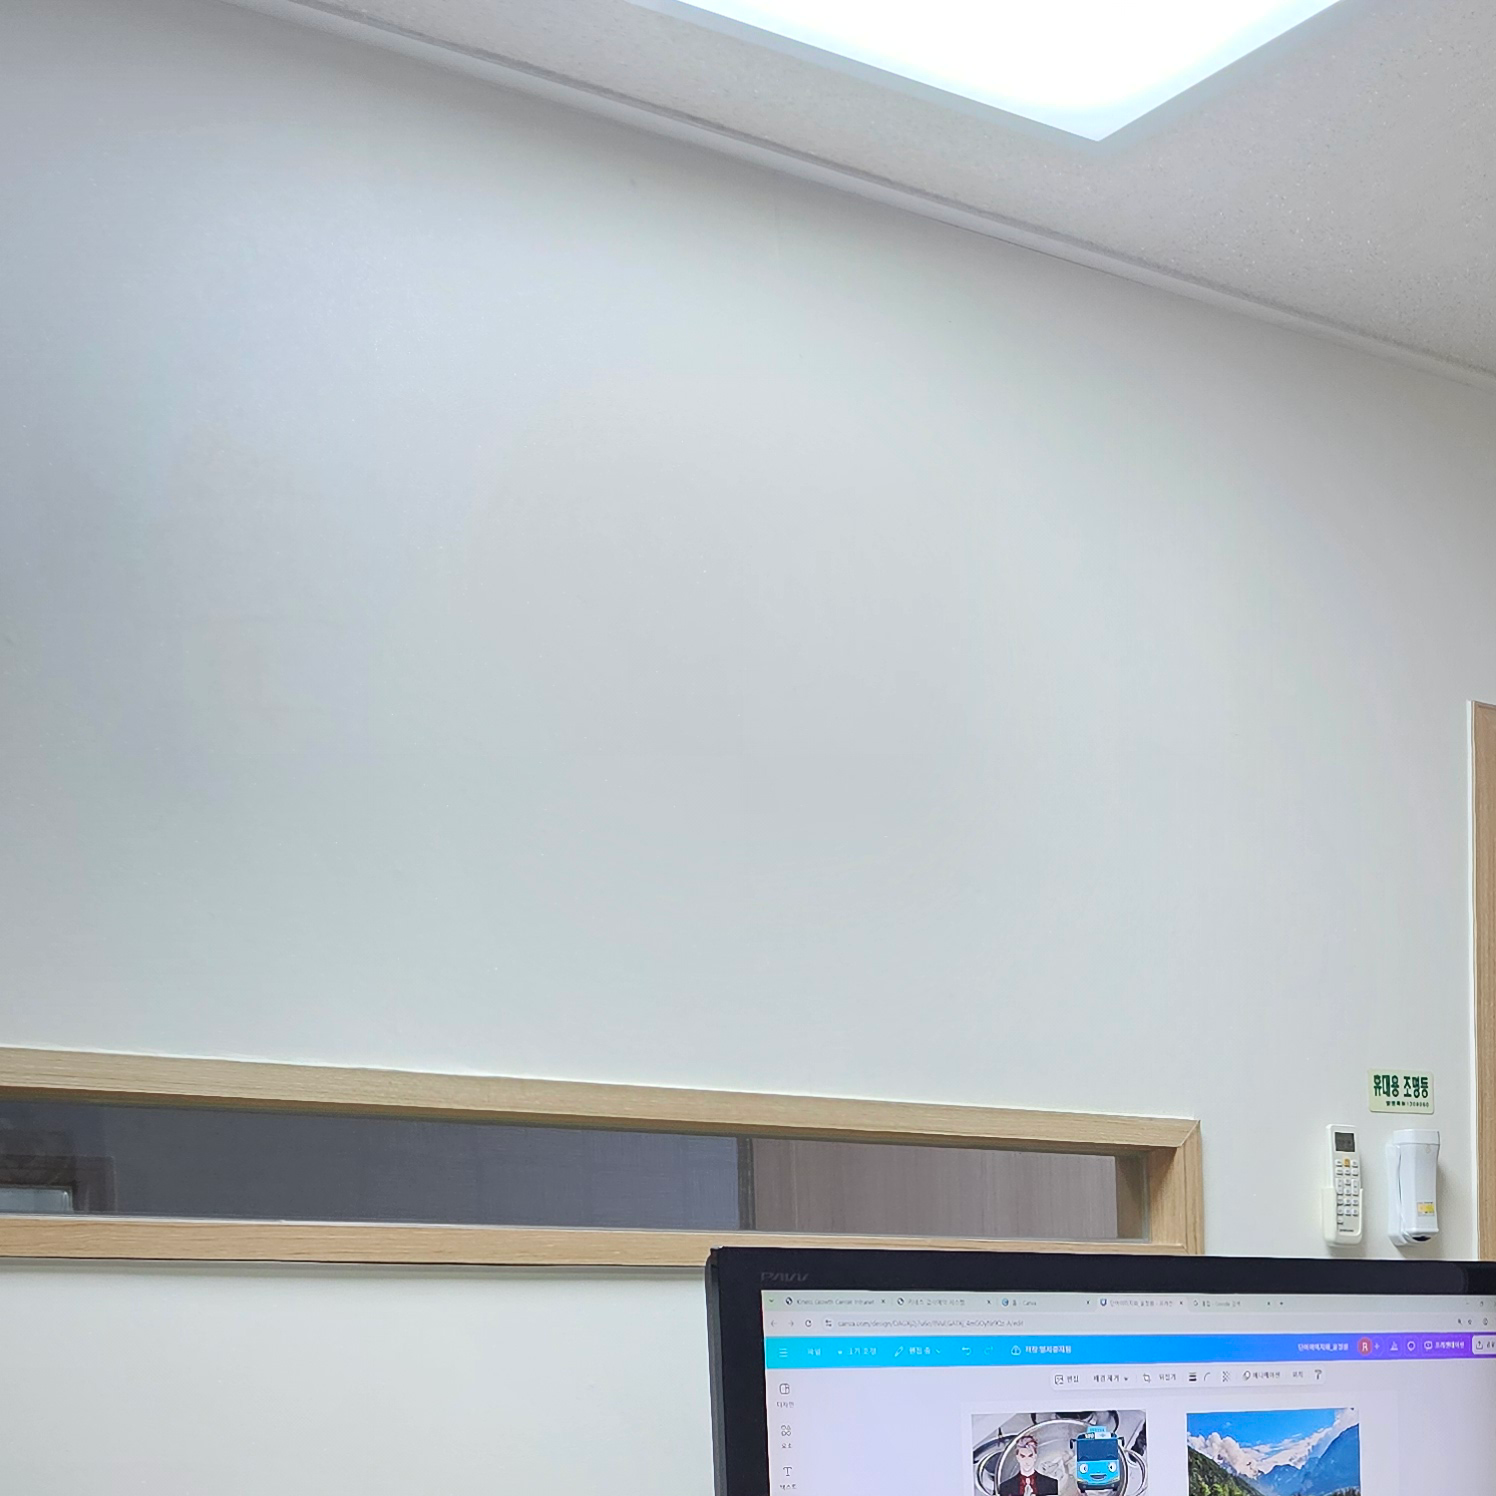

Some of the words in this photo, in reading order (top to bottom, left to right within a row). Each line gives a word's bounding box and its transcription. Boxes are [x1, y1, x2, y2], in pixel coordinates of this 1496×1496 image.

[1373, 1075, 1399, 1097] 휴대용
[1403, 1076, 1429, 1098] 조명등
[1361, 1342, 1368, 1352] R
